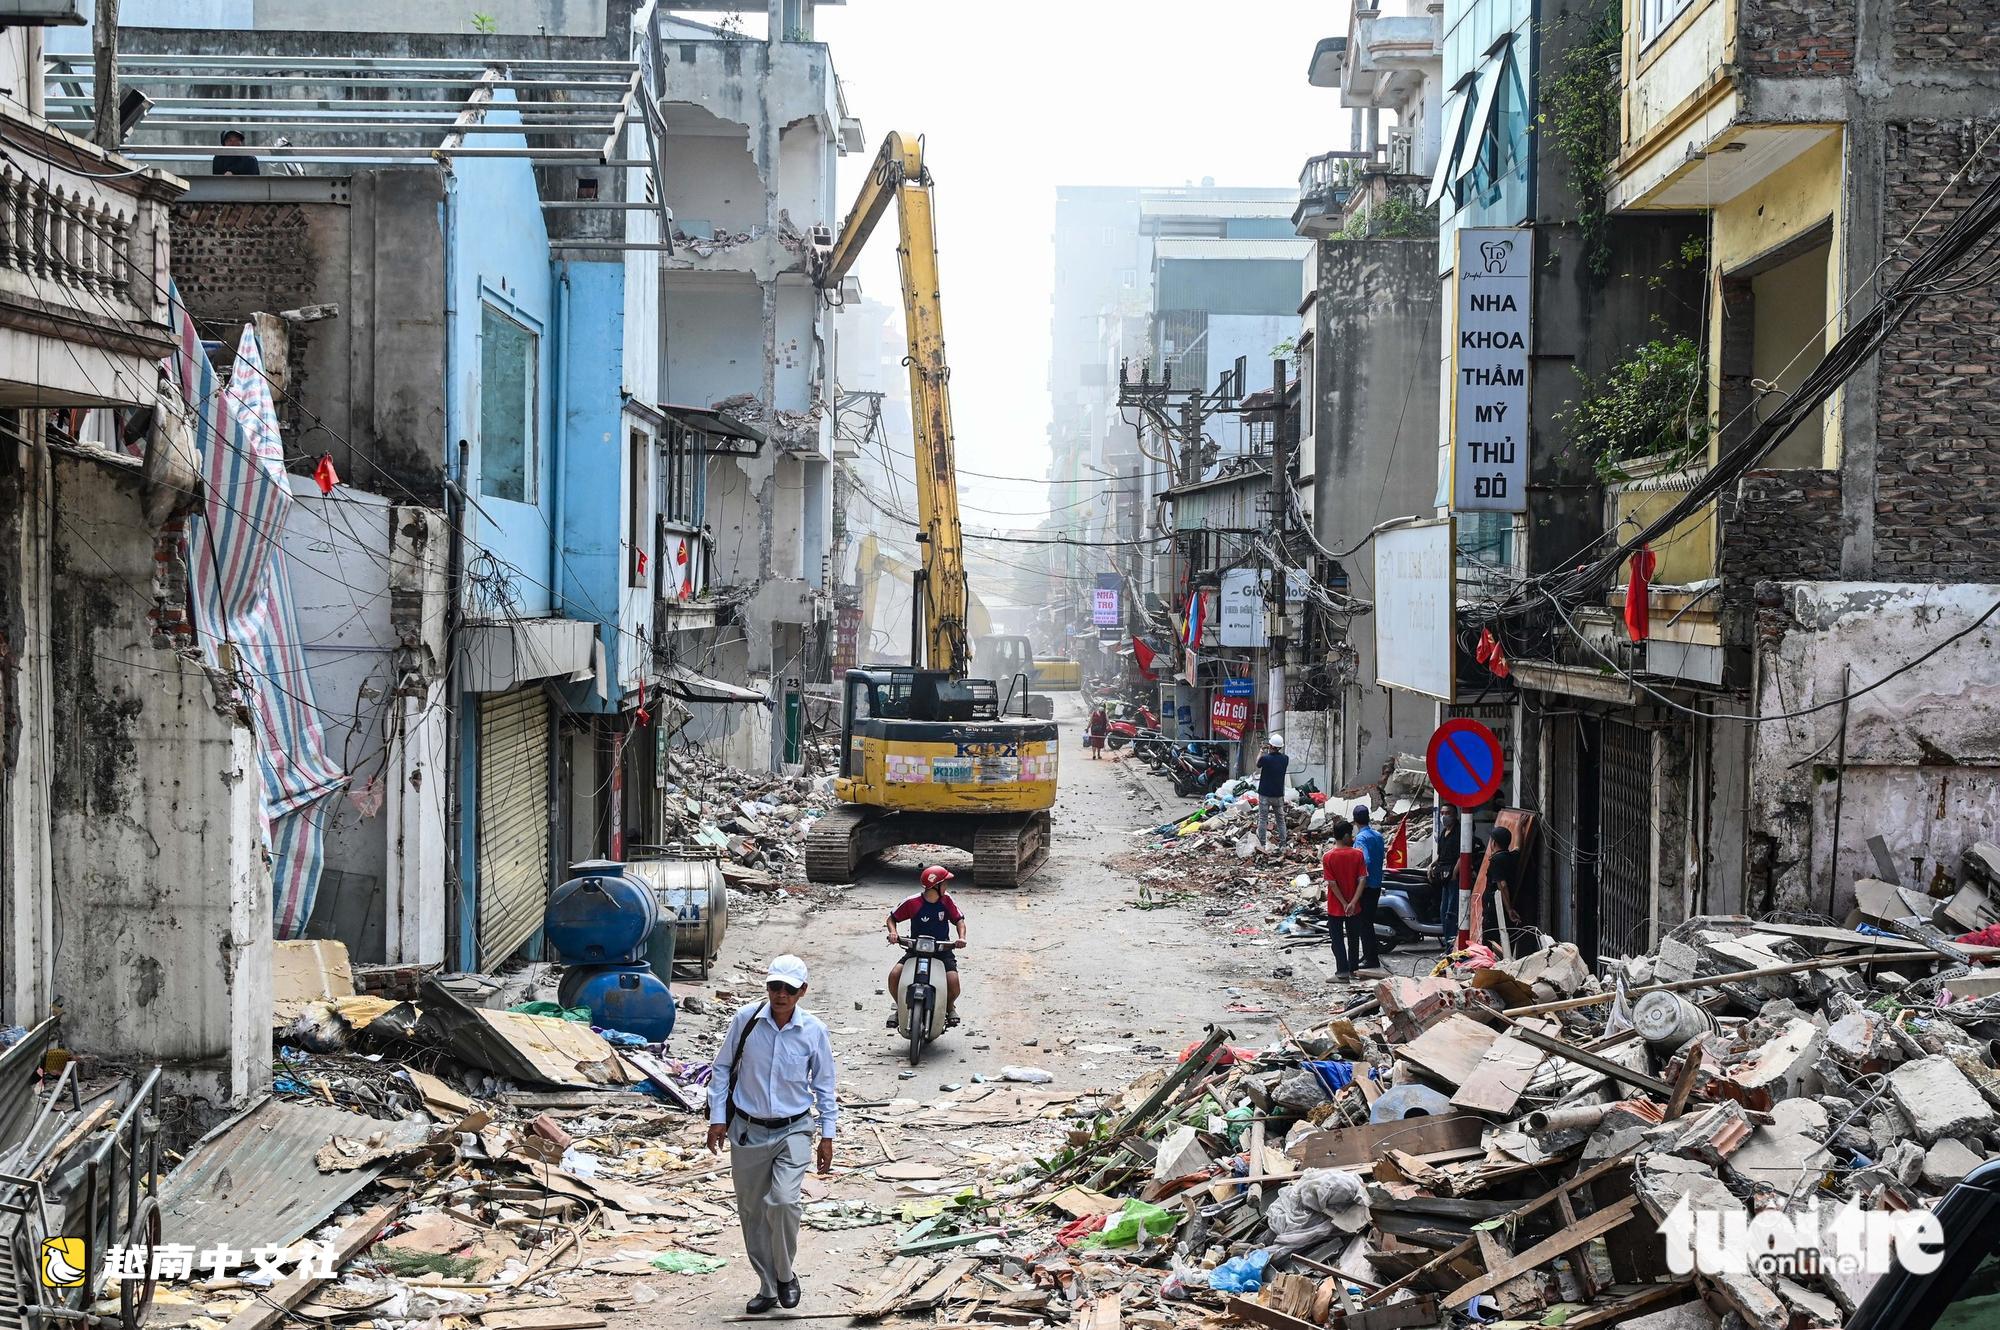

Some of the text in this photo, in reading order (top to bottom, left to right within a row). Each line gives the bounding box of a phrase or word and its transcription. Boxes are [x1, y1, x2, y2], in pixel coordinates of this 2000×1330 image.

[1470, 294, 1517, 312] NHA
[1461, 331, 1524, 349] KHOA
[1475, 401, 1508, 423] MỸ
[1468, 436, 1515, 464] THỦ
[1474, 476, 1508, 499] ĐÔ
[786, 678, 800, 688] 23
[1213, 697, 1248, 723] CẮT GỘI
[1479, 705, 1513, 718] KHOA
